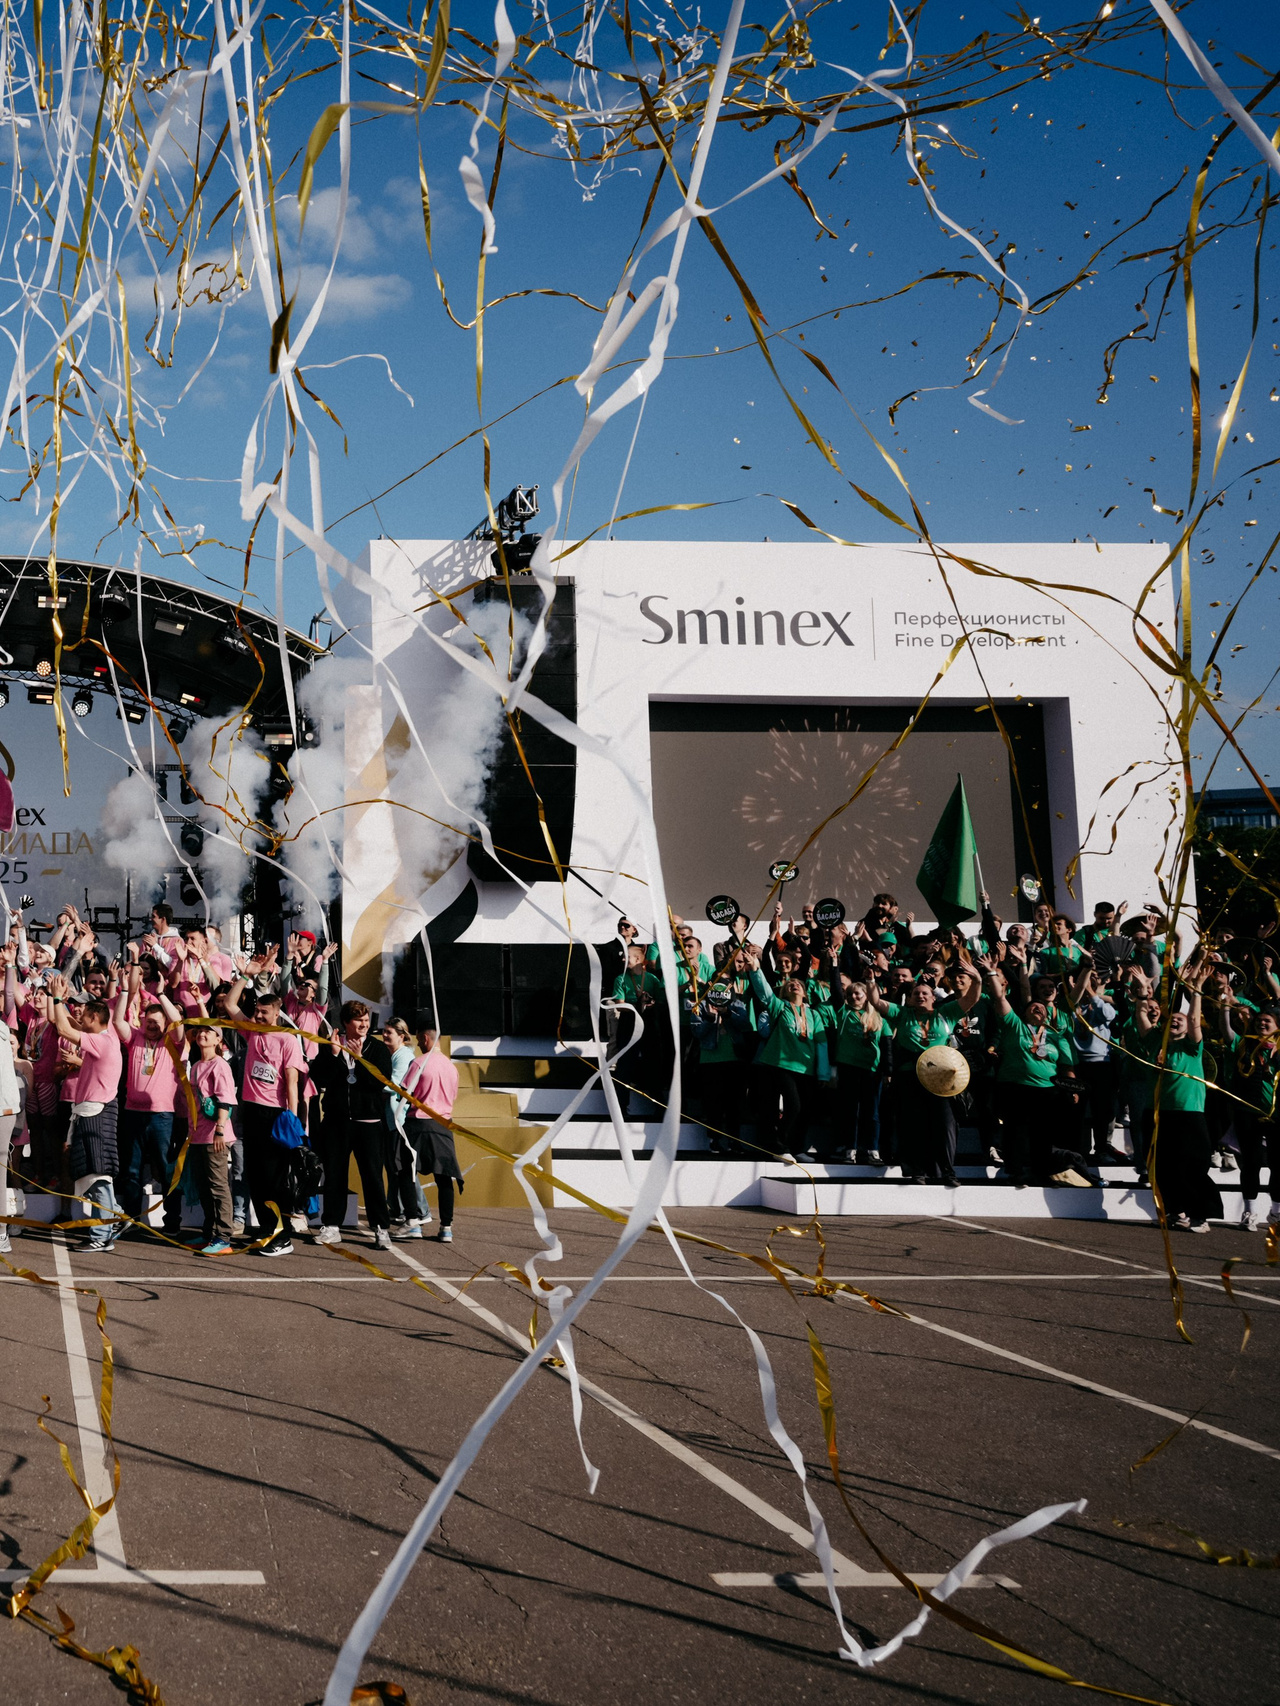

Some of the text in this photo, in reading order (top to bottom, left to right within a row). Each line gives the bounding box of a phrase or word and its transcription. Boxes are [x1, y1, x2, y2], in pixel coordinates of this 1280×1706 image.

[639, 594, 856, 647] Sminex
[894, 611, 1066, 629] Перфекционисты
[894, 633, 1067, 650] Fine Dvelopent
[710, 906, 737, 921] ВАСАБИ
[816, 911, 841, 921] ВАСАБИ
